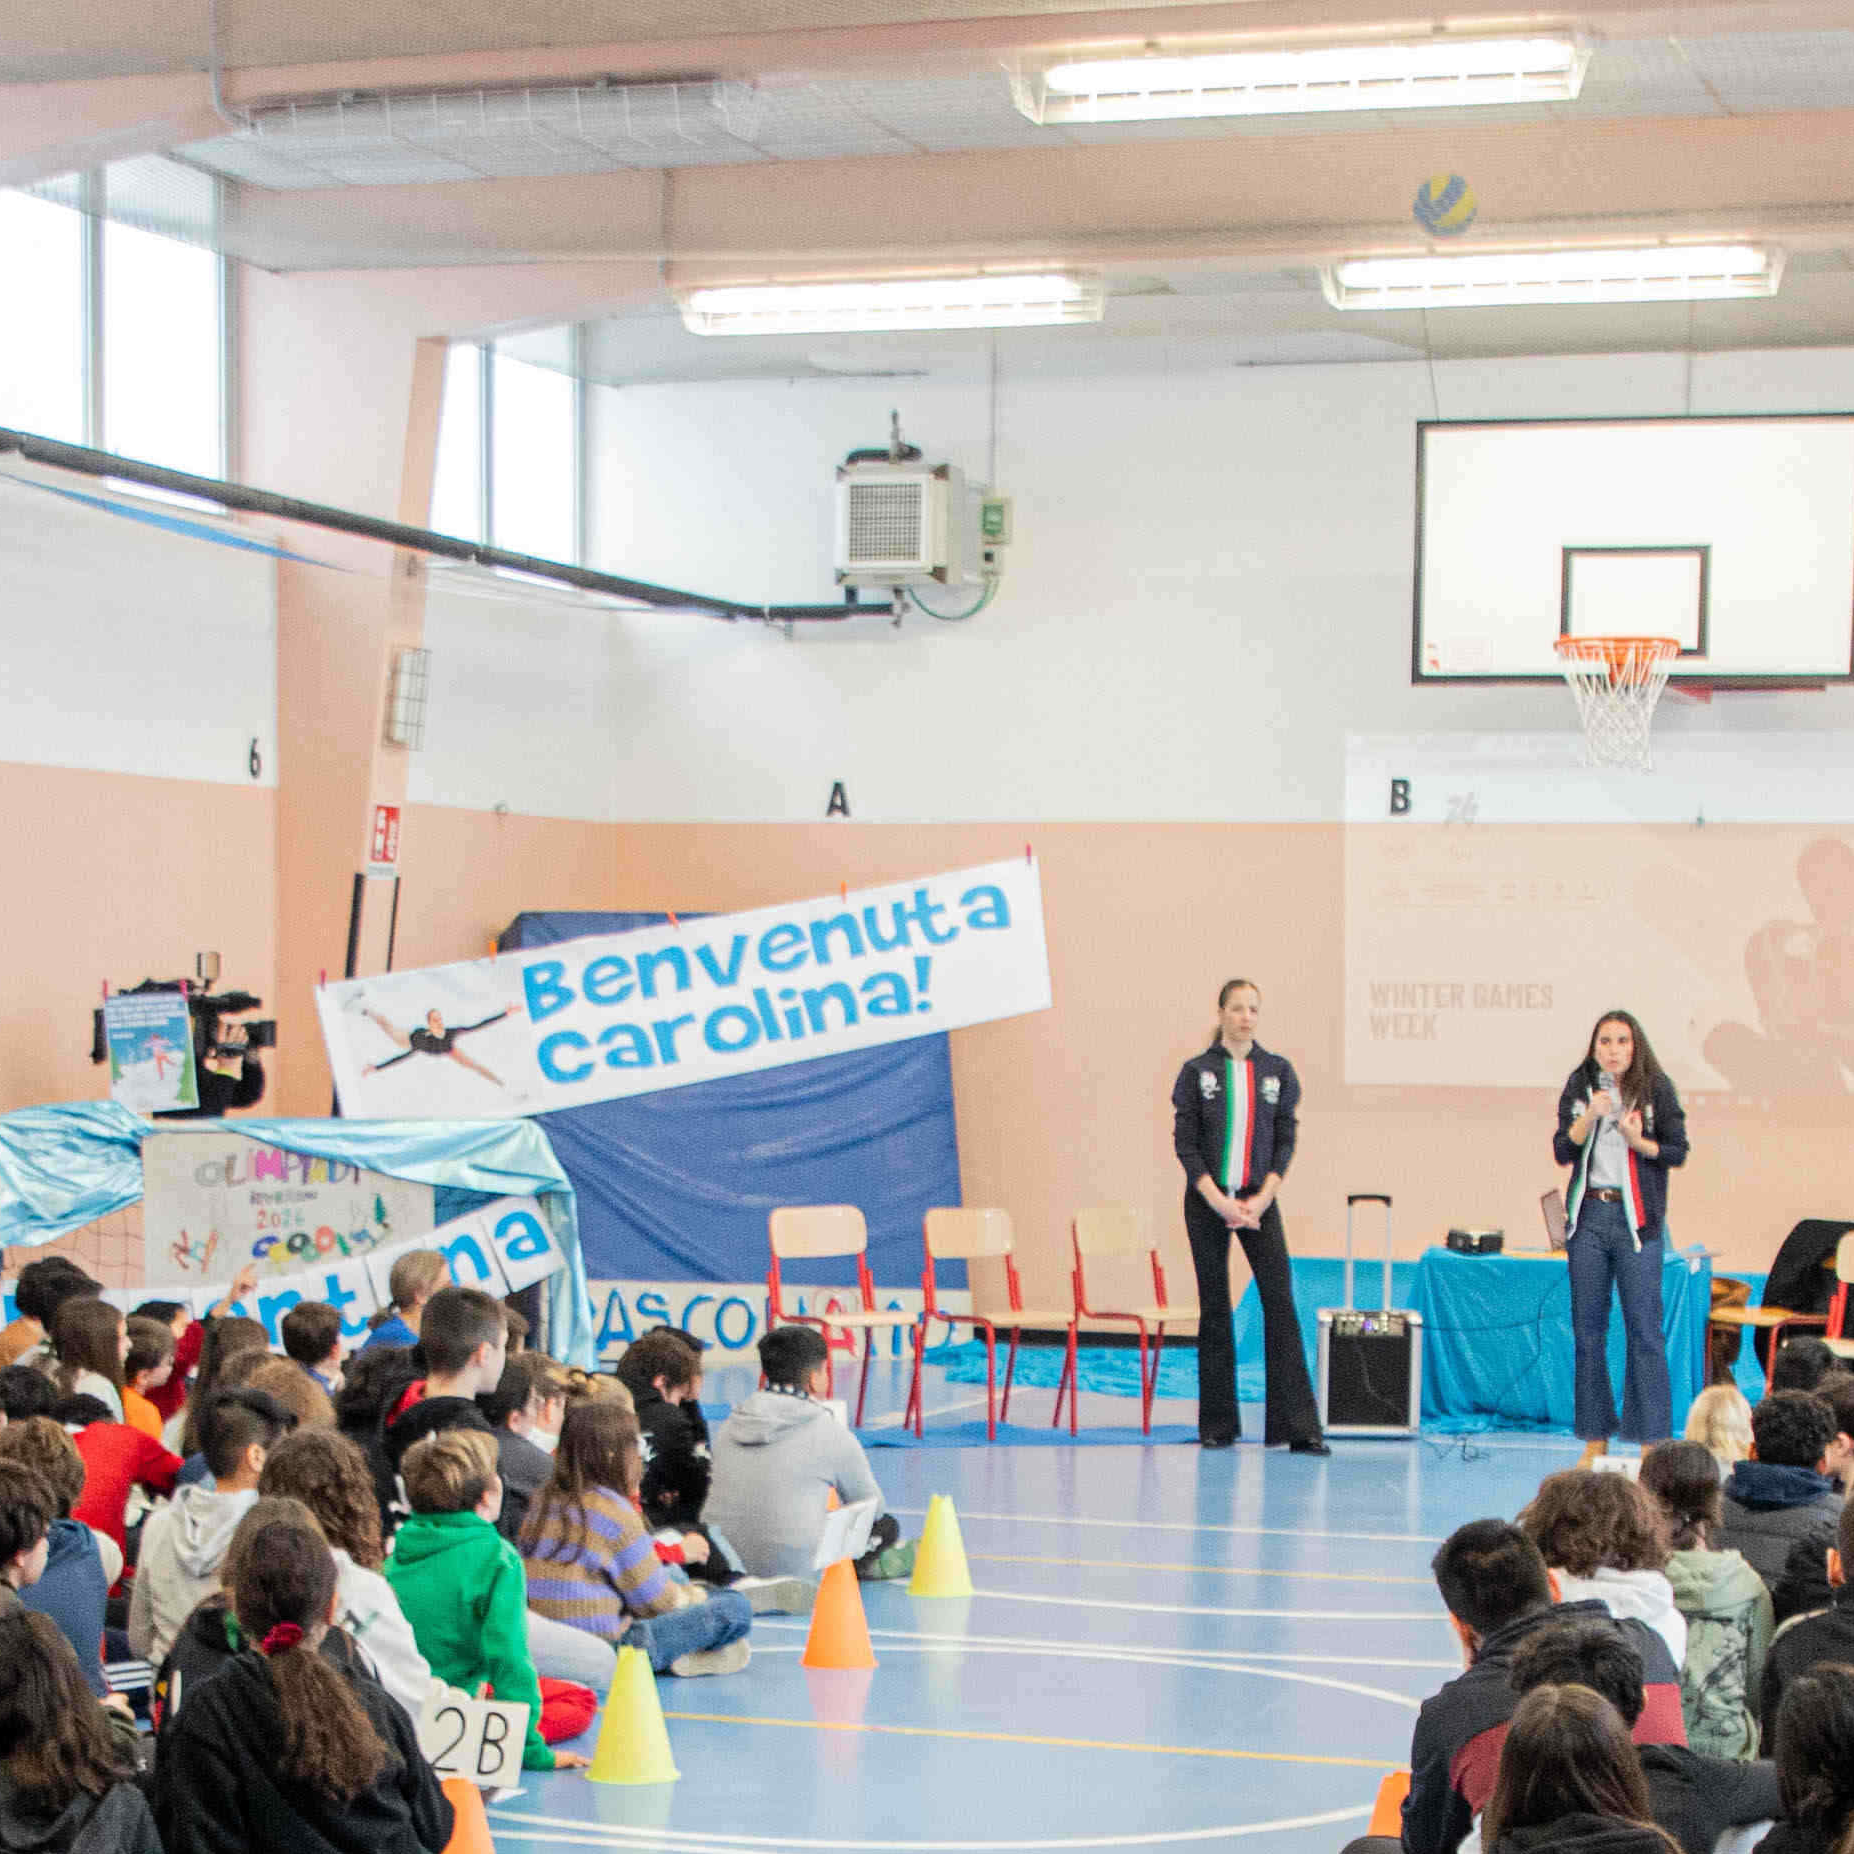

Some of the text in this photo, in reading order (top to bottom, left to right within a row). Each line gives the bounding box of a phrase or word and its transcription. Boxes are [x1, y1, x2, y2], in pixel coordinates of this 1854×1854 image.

[248, 737, 262, 779] 6
[826, 780, 850, 817] A
[1391, 778, 1411, 814] B
[522, 884, 1012, 1023] Benvenuta
[1369, 982, 1554, 1009] WINTER GAMES
[1369, 1013, 1438, 1040] WEEK
[431, 1706, 509, 1775] 2B
